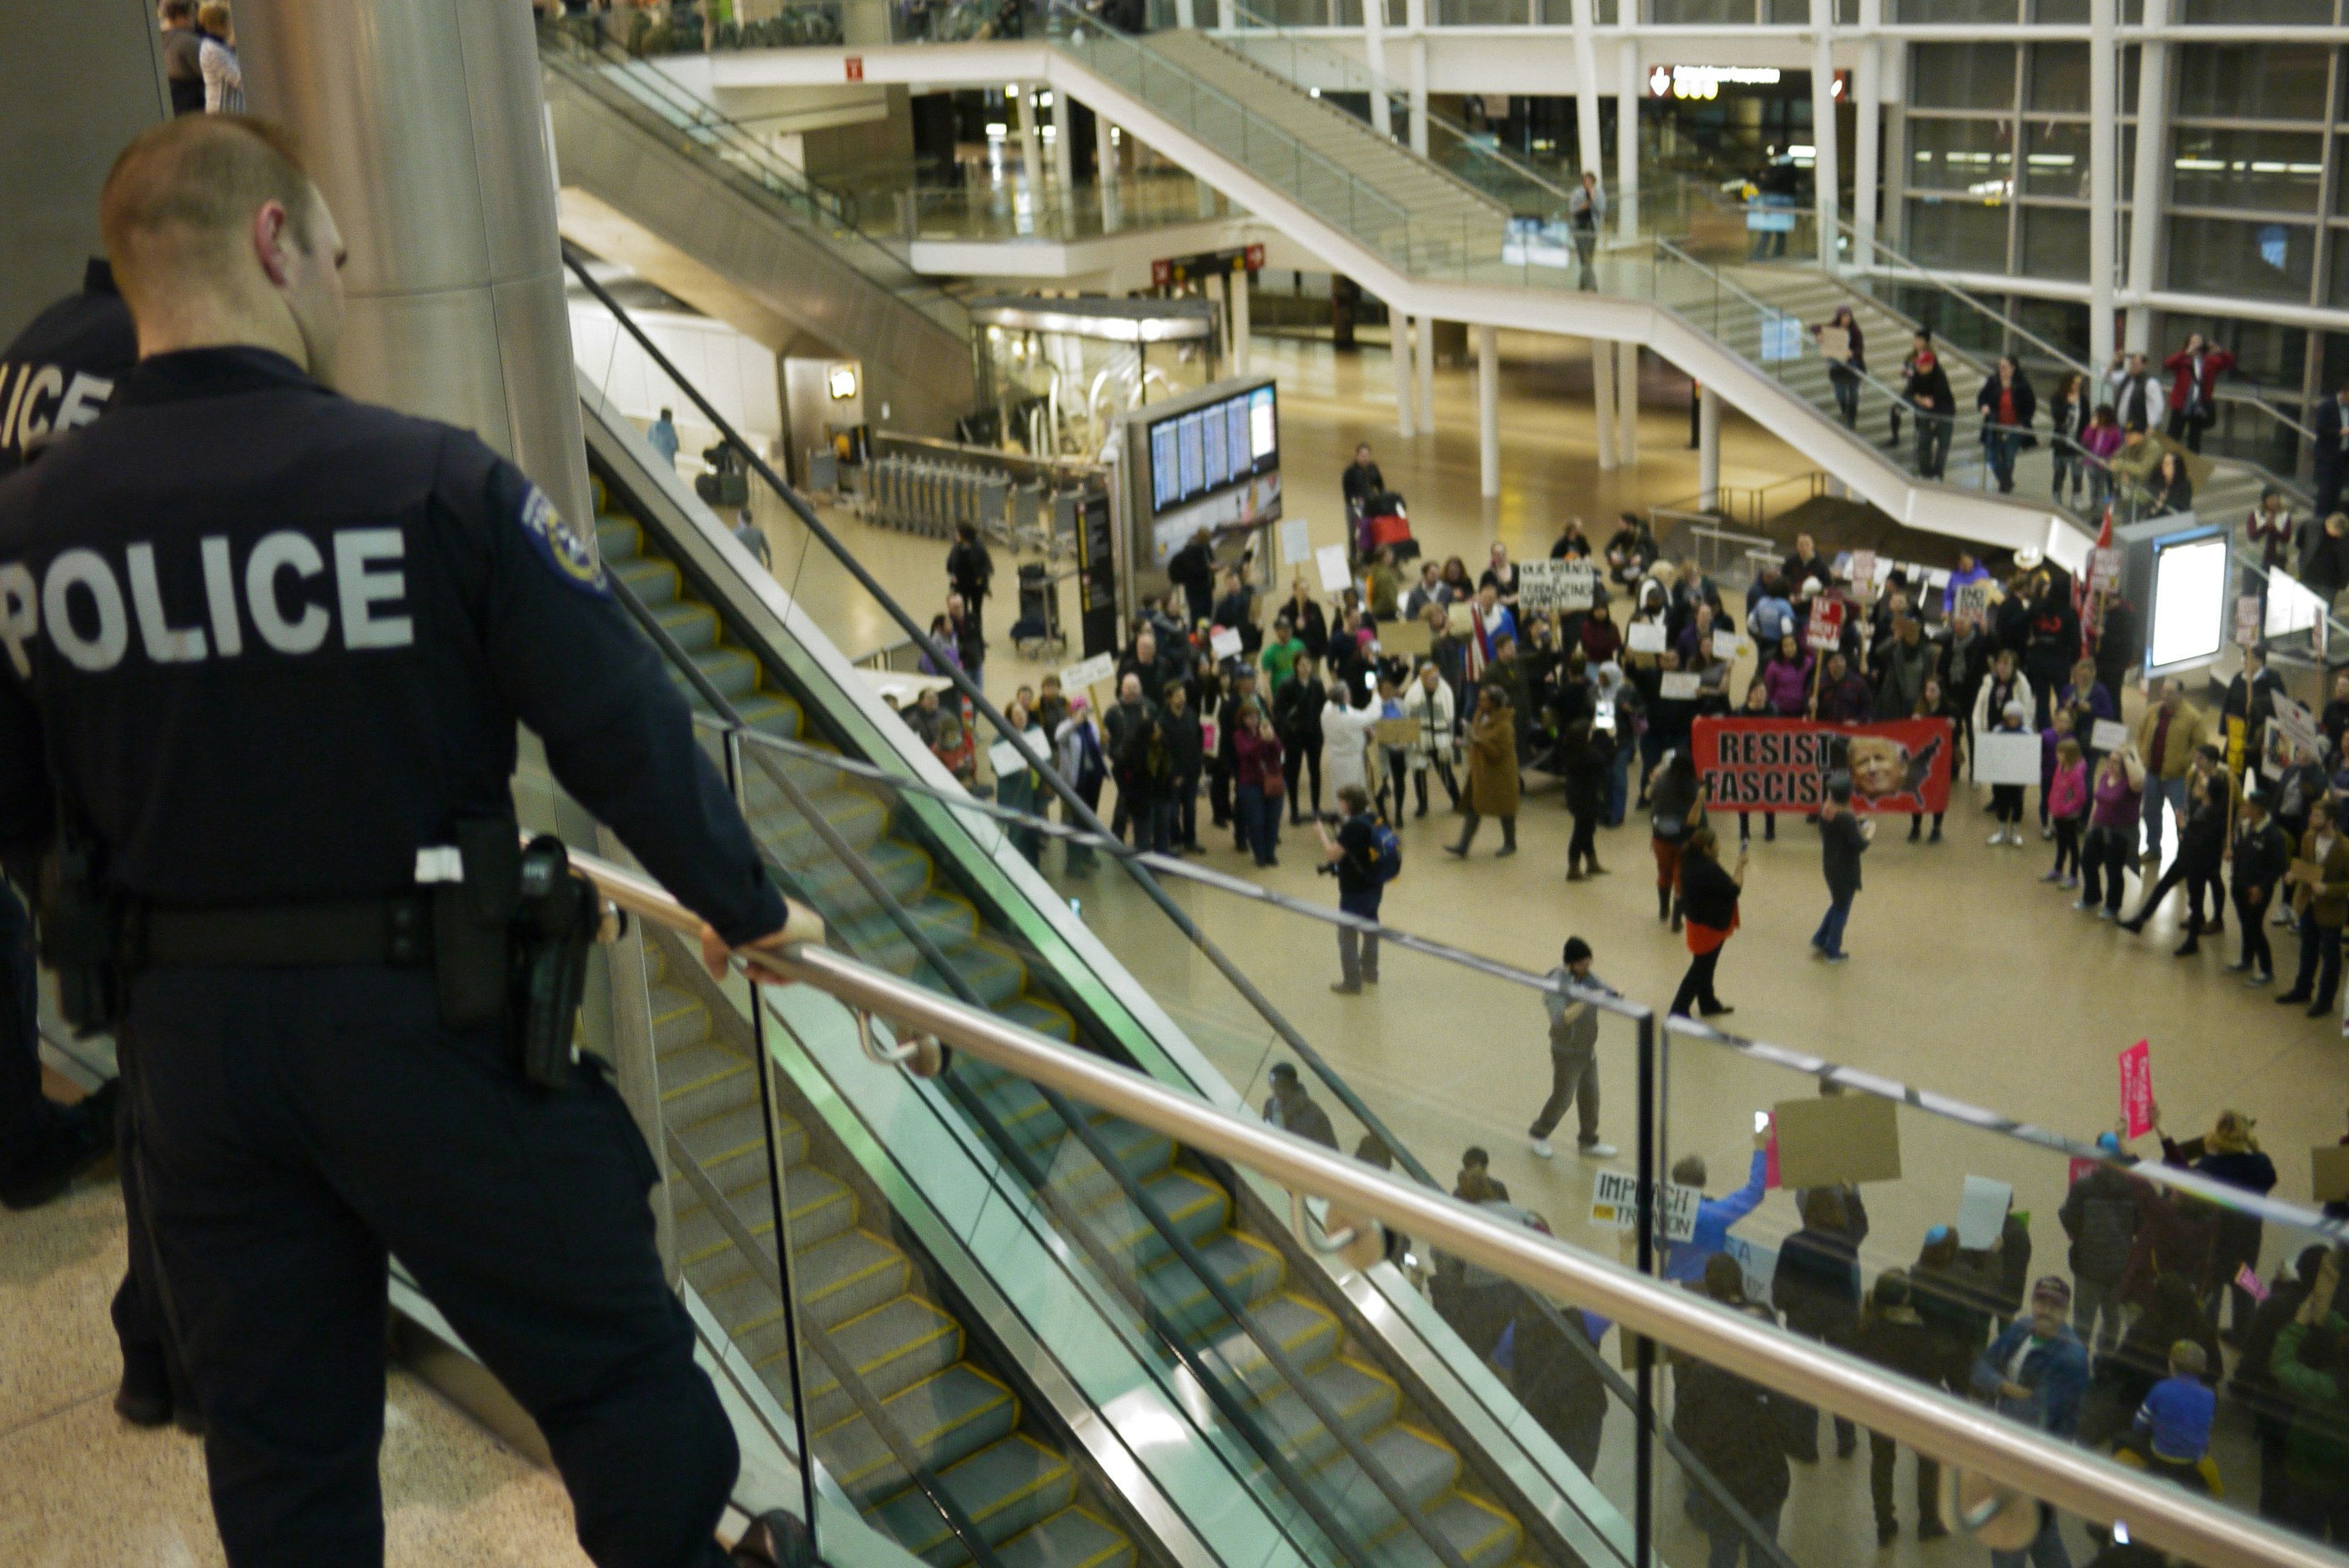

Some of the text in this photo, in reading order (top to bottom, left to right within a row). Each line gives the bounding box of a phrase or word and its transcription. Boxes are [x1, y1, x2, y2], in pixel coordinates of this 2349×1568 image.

[0, 528, 415, 679] POLICE
[1719, 731, 1835, 766] RESIST
[1600, 1173, 1689, 1214] IMPACH
